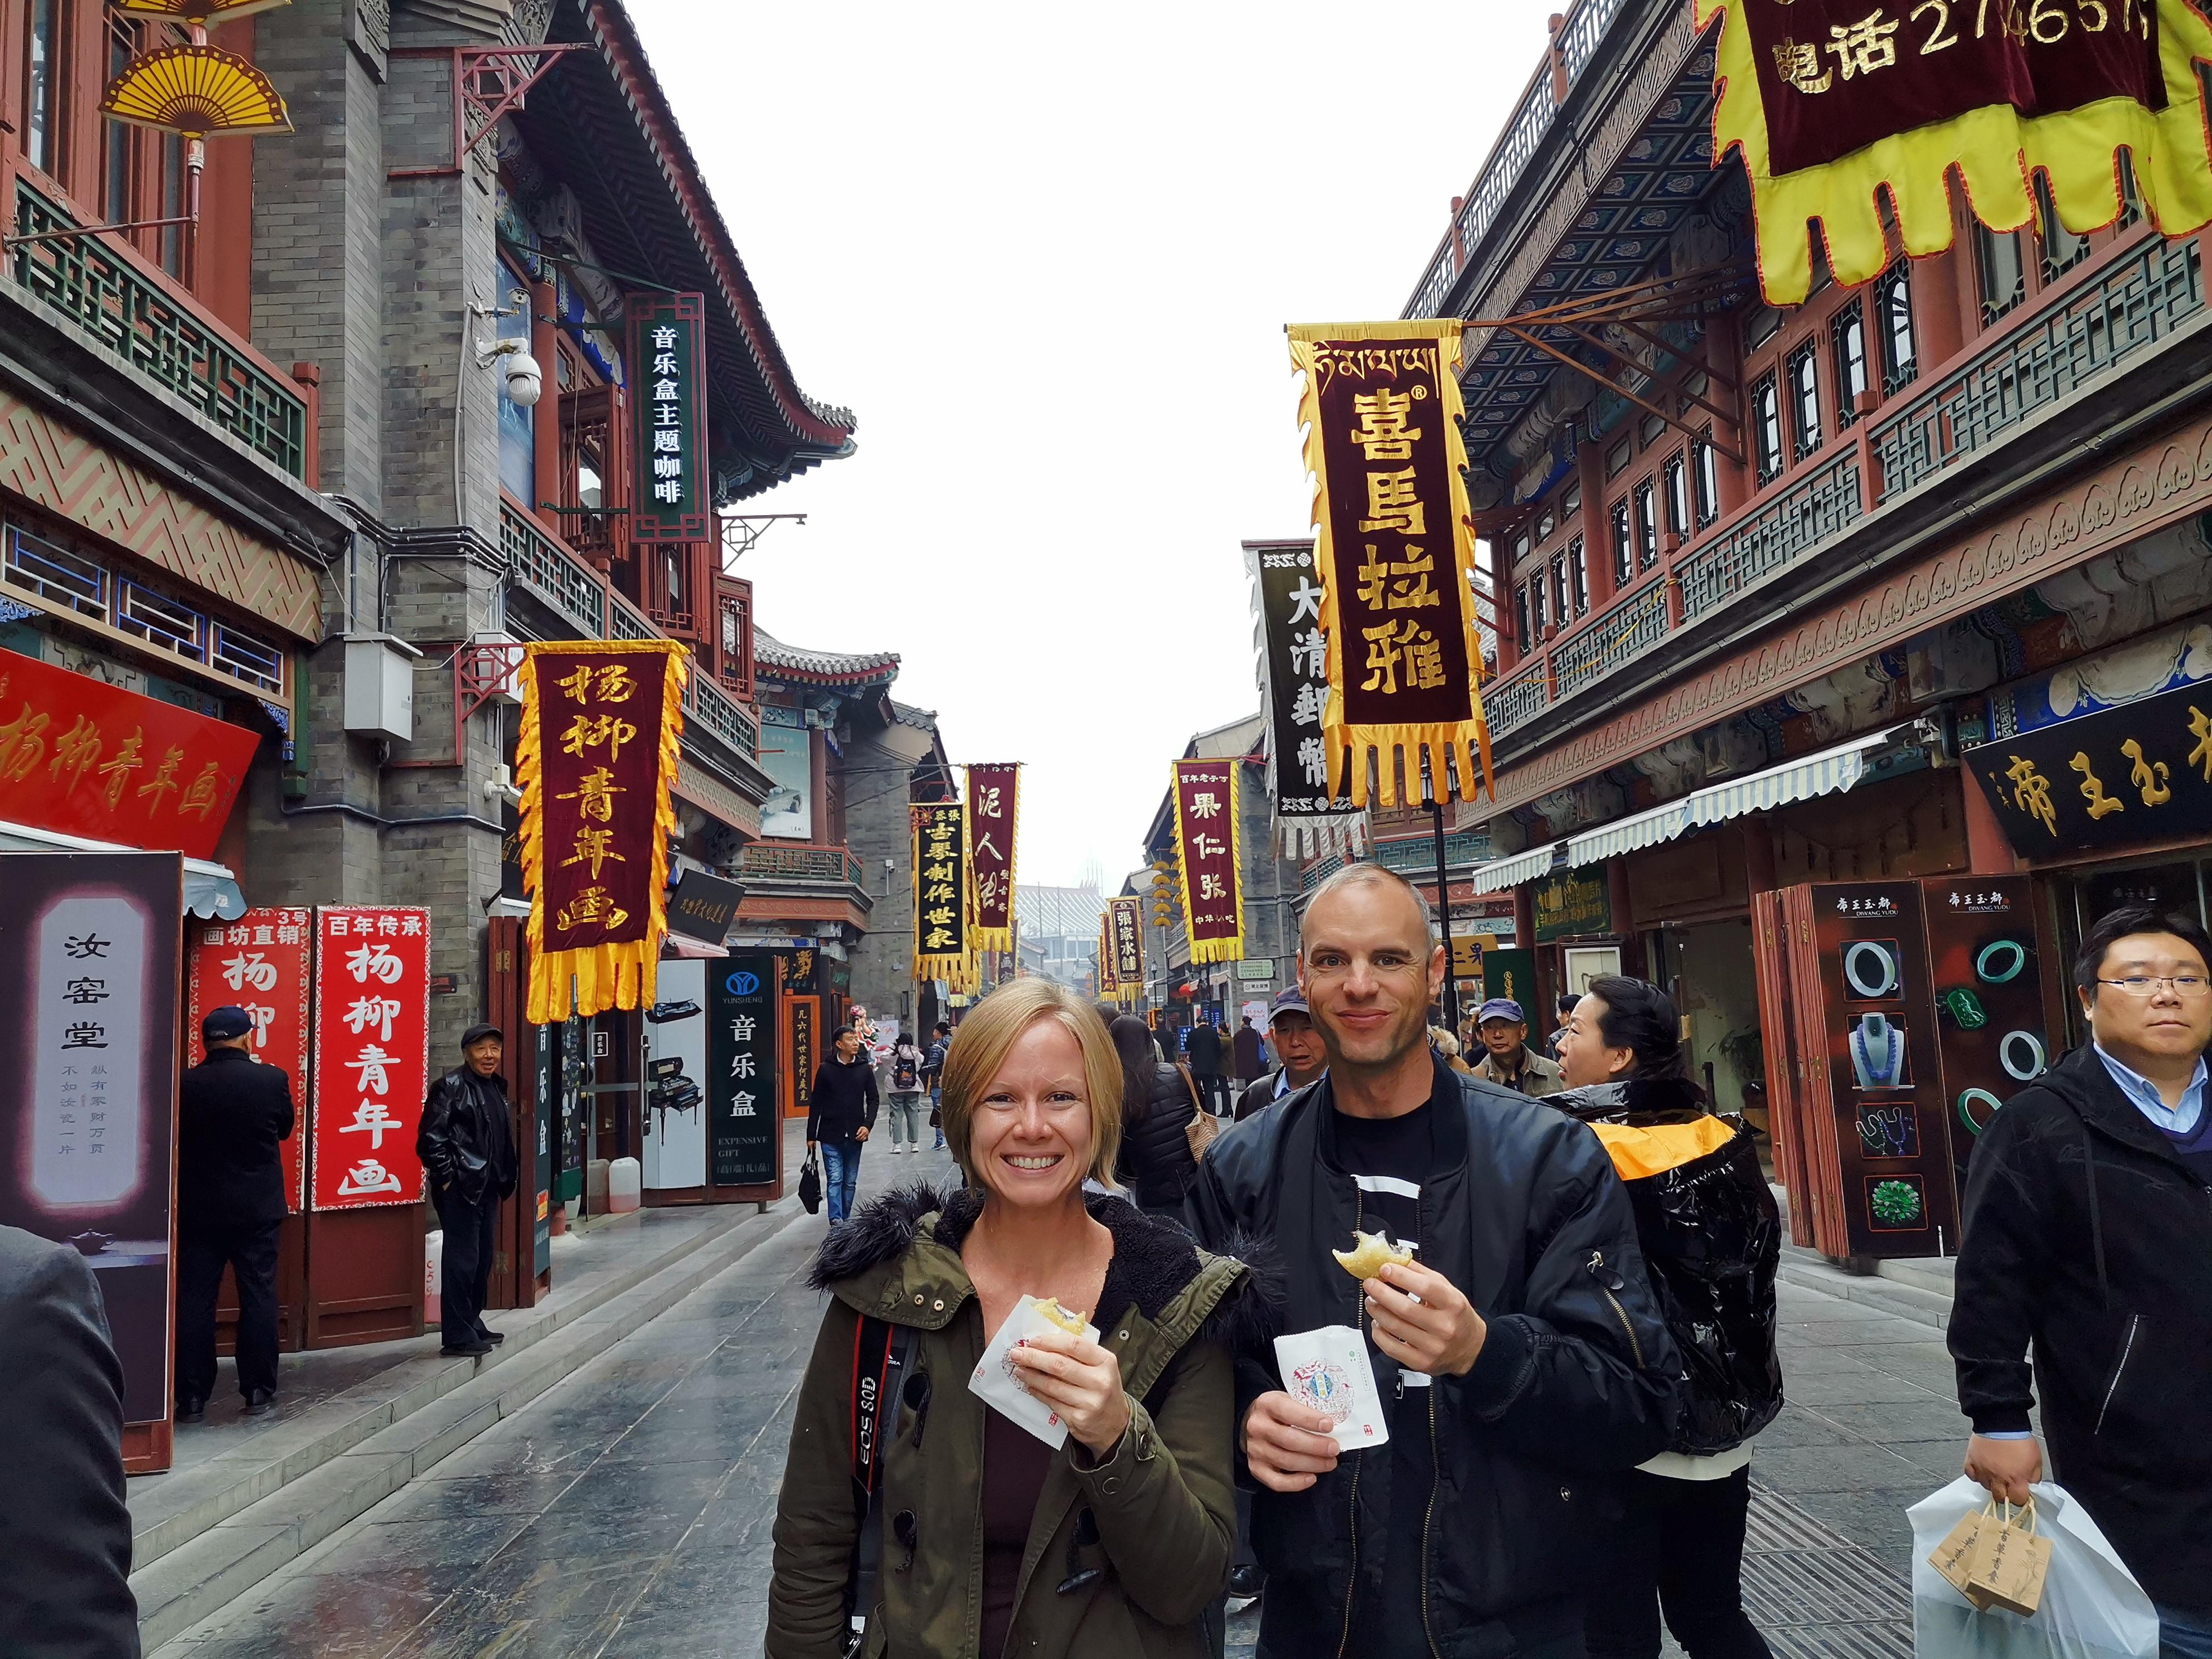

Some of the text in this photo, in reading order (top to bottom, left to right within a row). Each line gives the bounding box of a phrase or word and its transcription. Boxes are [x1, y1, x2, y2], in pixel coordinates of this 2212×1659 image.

[651, 326, 683, 503] 音乐盒主题咖啡
[278, 911, 308, 925] 3号
[328, 915, 423, 937] 百年传承
[203, 925, 300, 946] 画坊直销
[60, 933, 111, 1050] 汝窑堂
[730, 1014, 756, 1117] 音乐盒
[719, 1136, 768, 1146] EXPENSIVE
[719, 1149, 740, 1158] GIFT
[860, 1376, 876, 1464] EOS 80D
